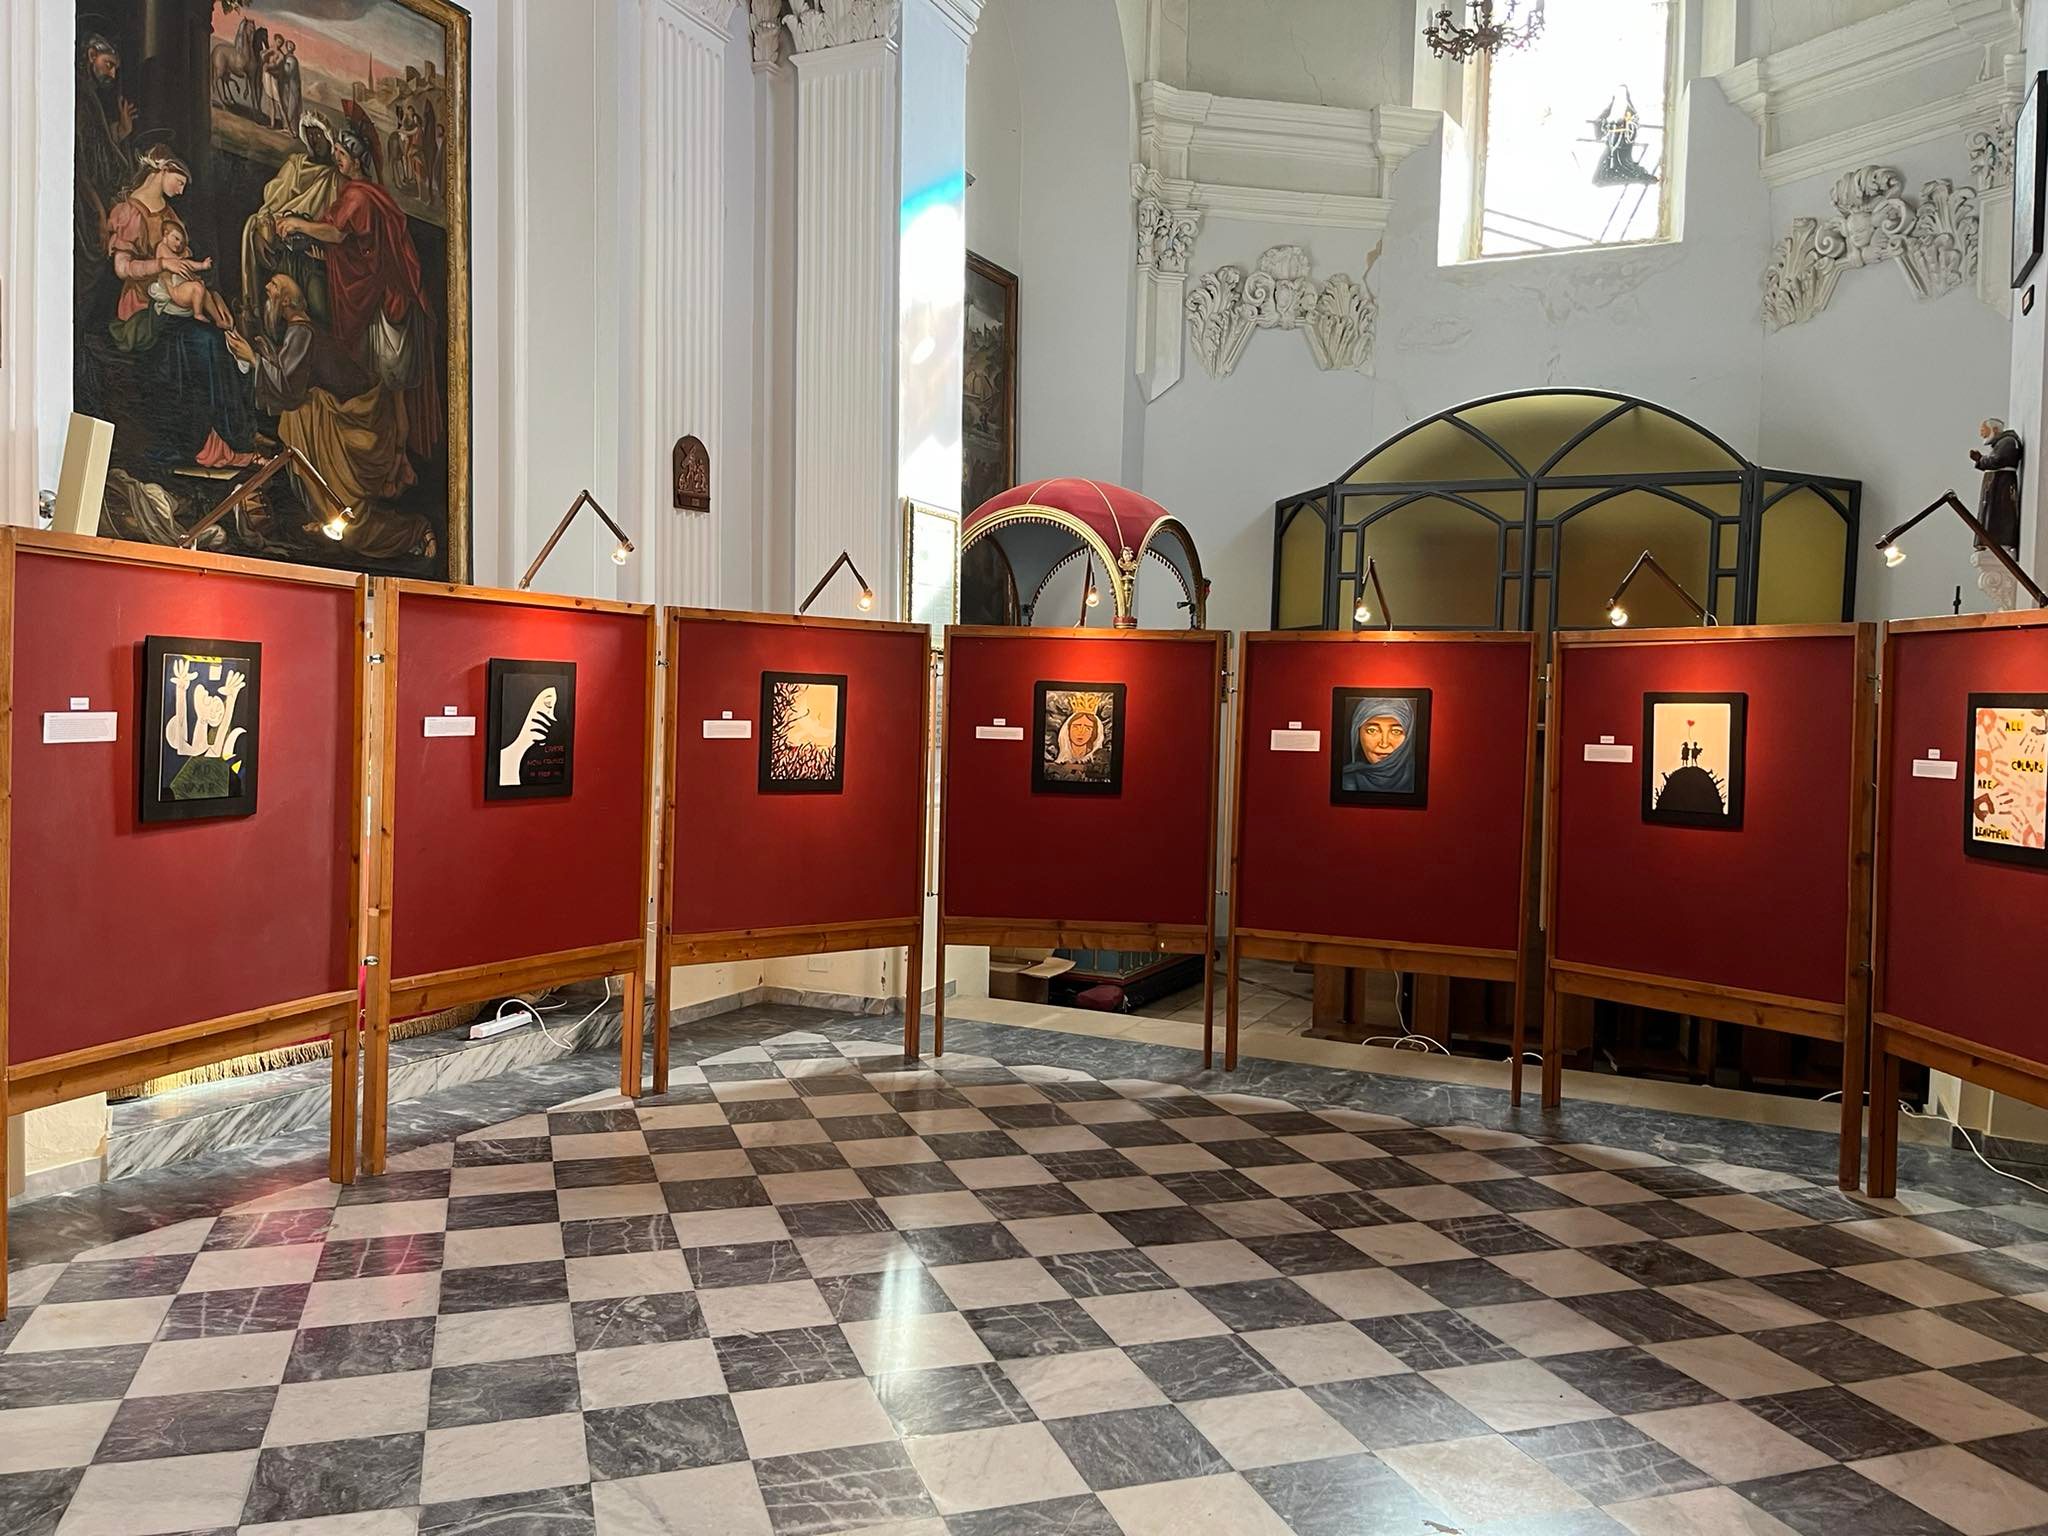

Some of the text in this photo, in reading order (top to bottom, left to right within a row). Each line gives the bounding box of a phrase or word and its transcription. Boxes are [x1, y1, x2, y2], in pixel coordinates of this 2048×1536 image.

[2004, 722, 2022, 731] ALL
[2011, 760, 2043, 773] COLOURS
[1977, 780, 1992, 789] ARE
[1975, 827, 2009, 840] BEAUTIFUL
